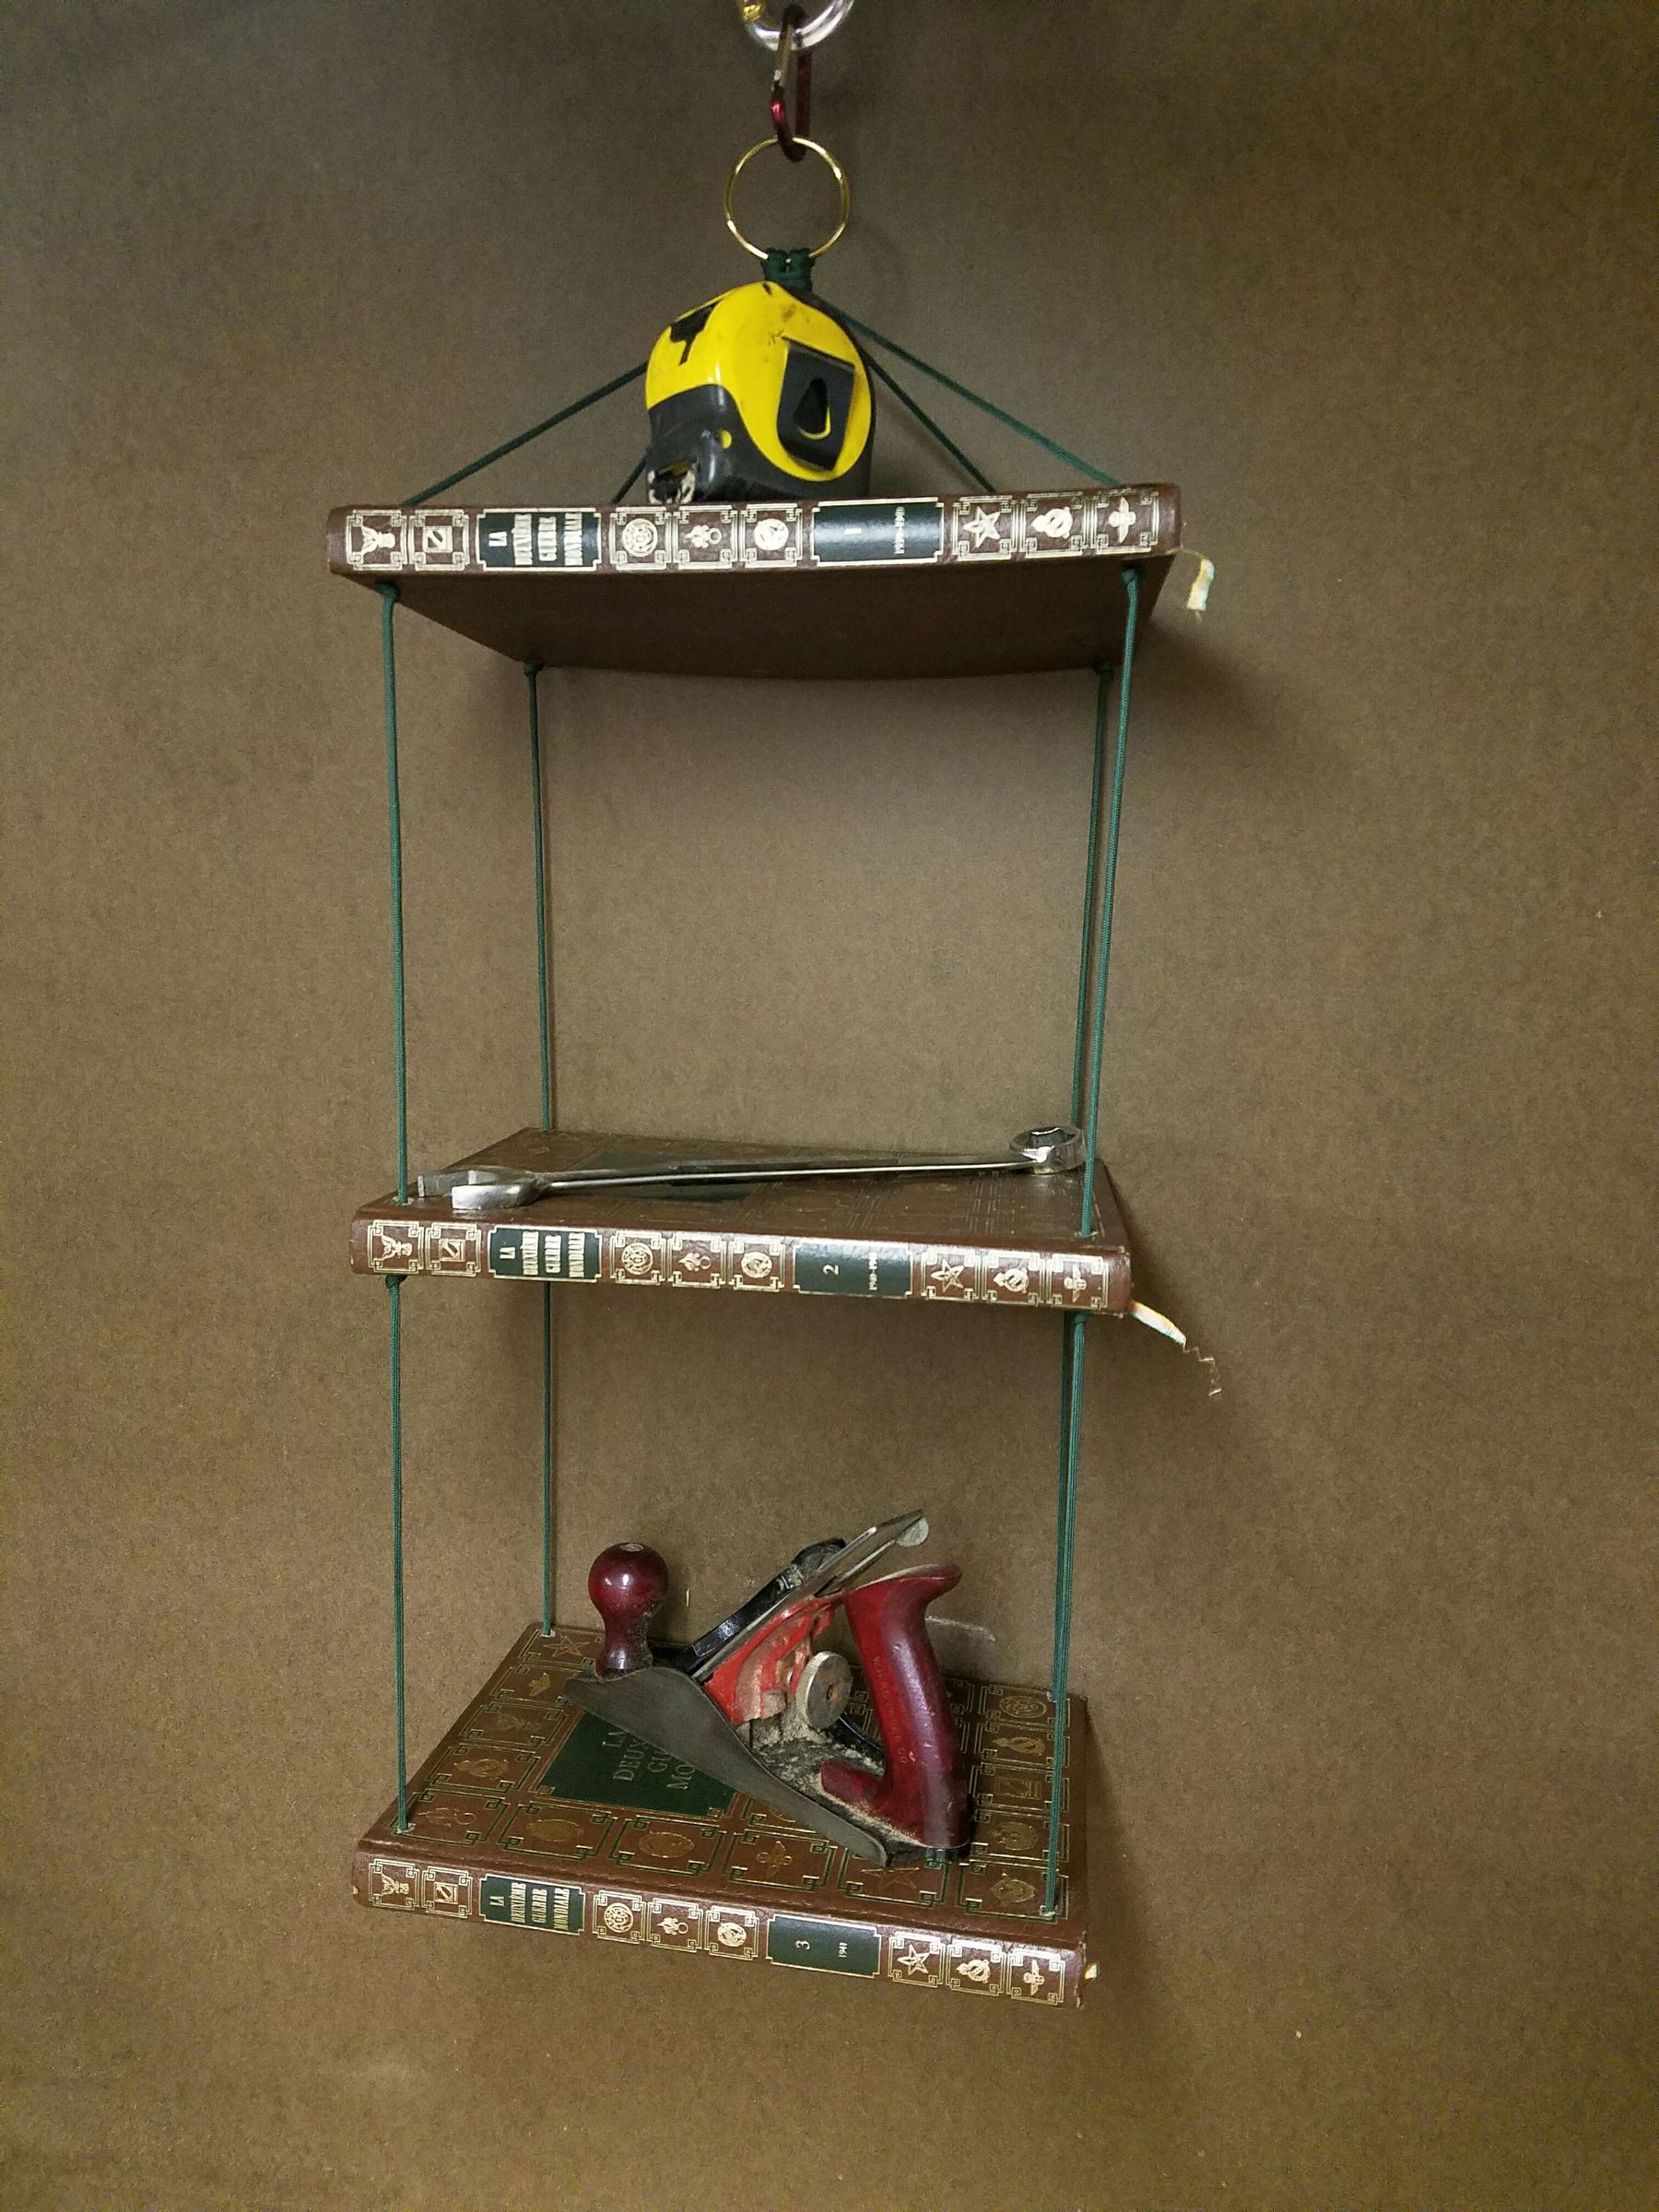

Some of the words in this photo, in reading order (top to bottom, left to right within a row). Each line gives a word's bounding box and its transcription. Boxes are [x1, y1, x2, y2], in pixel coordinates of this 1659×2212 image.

[488, 531, 508, 547] LA
[500, 1247, 515, 1259] LA
[545, 1235, 561, 1274] GUERRE
[568, 1232, 585, 1278] MONDIALE
[822, 1265, 840, 1276] 2
[489, 1896, 505, 1907] LA
[510, 1882, 526, 1924] DEUXIÈME
[532, 1888, 547, 1924] GUERRE
[553, 1888, 570, 1931] MONDIALE
[795, 1940, 810, 1950] 3
